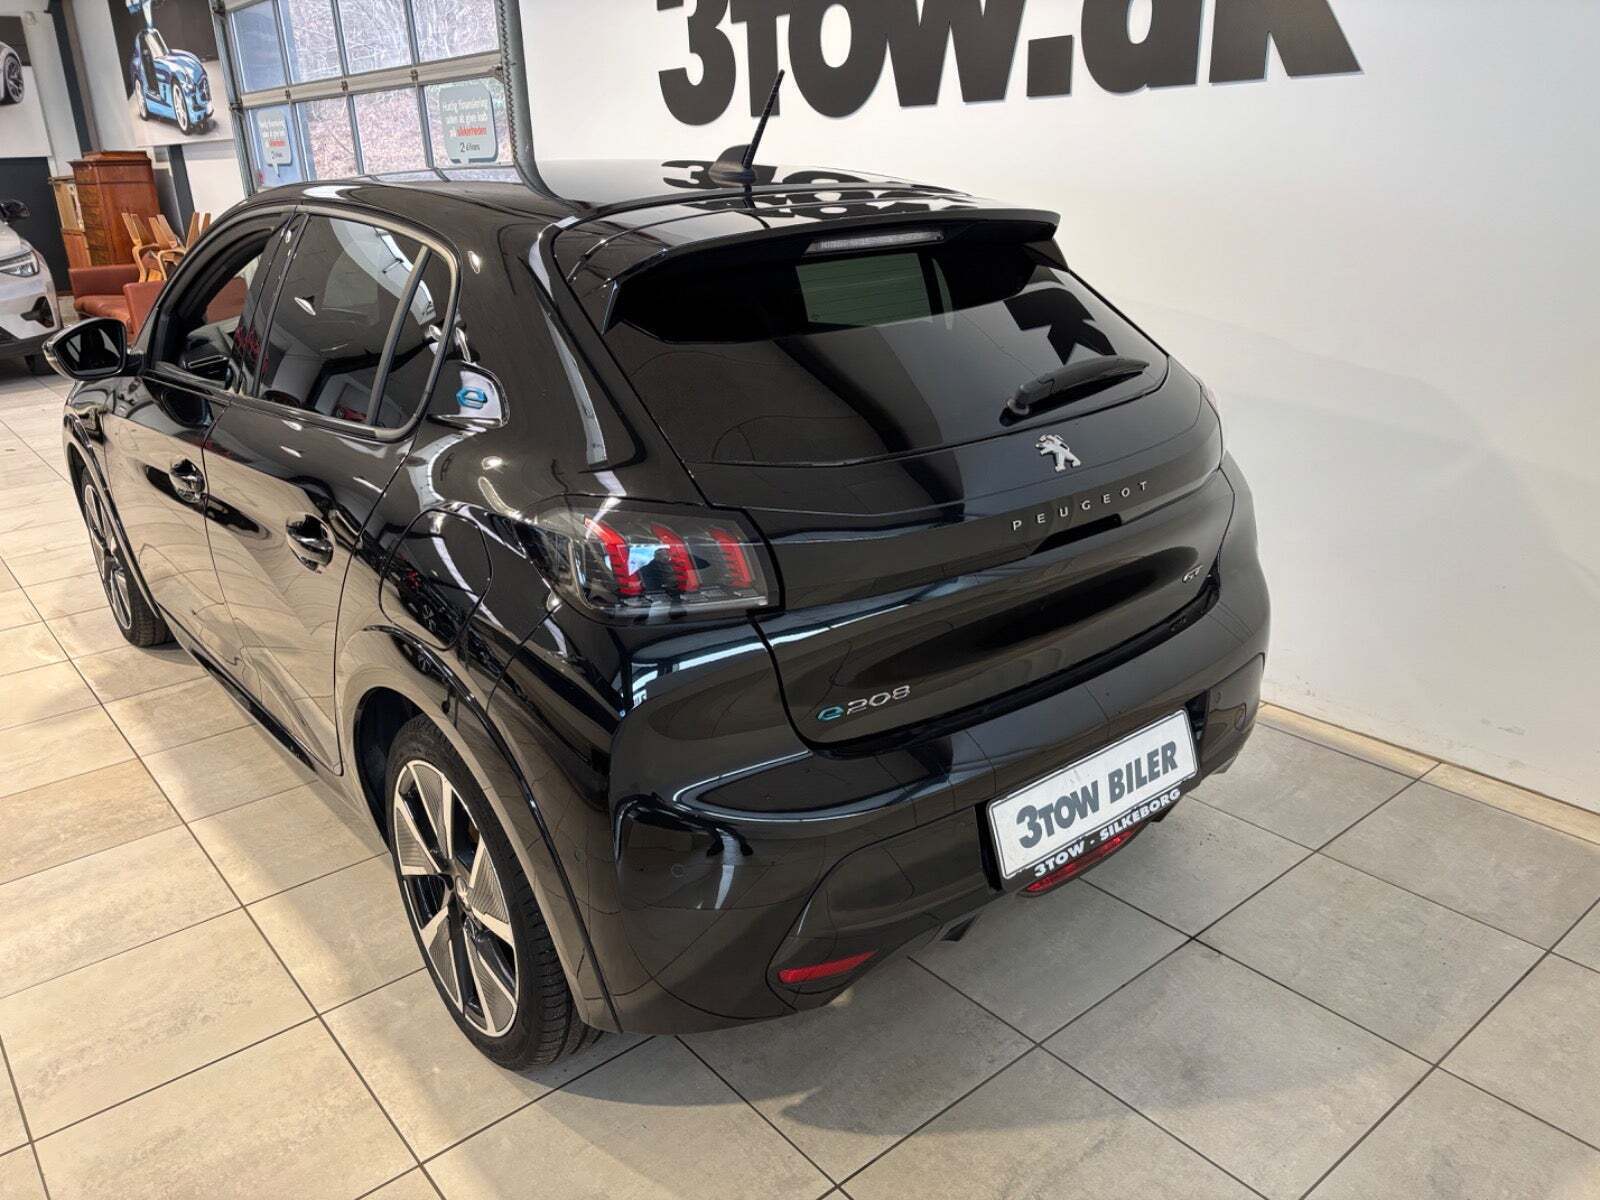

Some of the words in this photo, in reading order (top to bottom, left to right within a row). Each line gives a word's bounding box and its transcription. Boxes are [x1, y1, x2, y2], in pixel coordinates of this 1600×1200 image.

[1012, 481, 1148, 531] PEUGEOT
[1016, 780, 1100, 849] 3TOW
[1107, 741, 1178, 804] BILER
[1034, 840, 1085, 877] 3TOW
[1099, 788, 1181, 840] SILKEBORG
